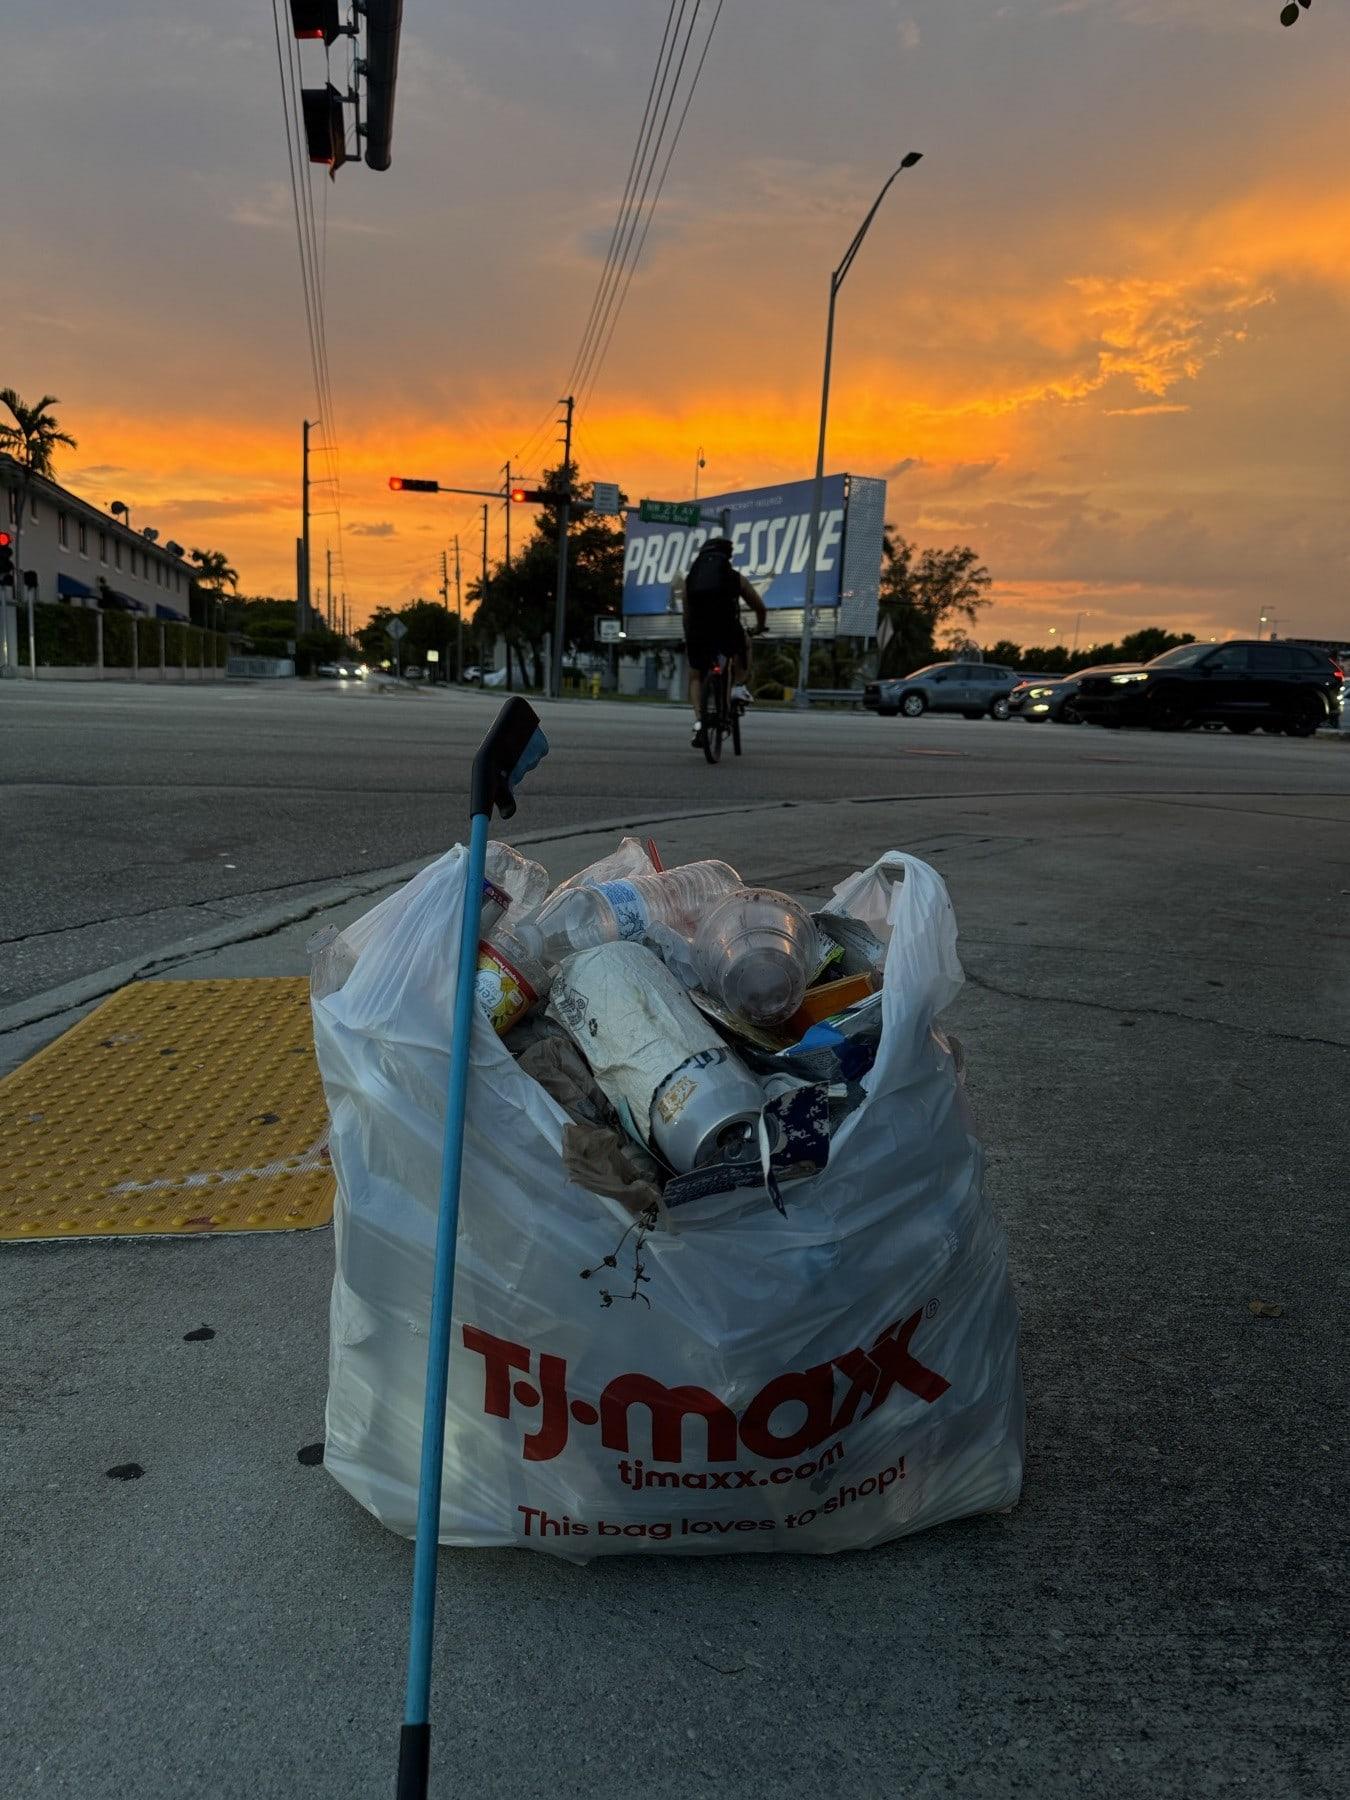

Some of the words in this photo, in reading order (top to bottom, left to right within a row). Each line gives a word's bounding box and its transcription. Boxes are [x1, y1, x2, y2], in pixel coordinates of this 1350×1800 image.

[664, 504, 679, 515] 27
[624, 509, 844, 587] PROGESSIVE
[518, 1505, 590, 1537] This
[598, 1521, 672, 1540] bag
[681, 1518, 777, 1535] loves
[784, 1509, 817, 1529] to
[823, 1456, 906, 1515] shop!
[618, 1441, 845, 1491] tjmaxx.com
